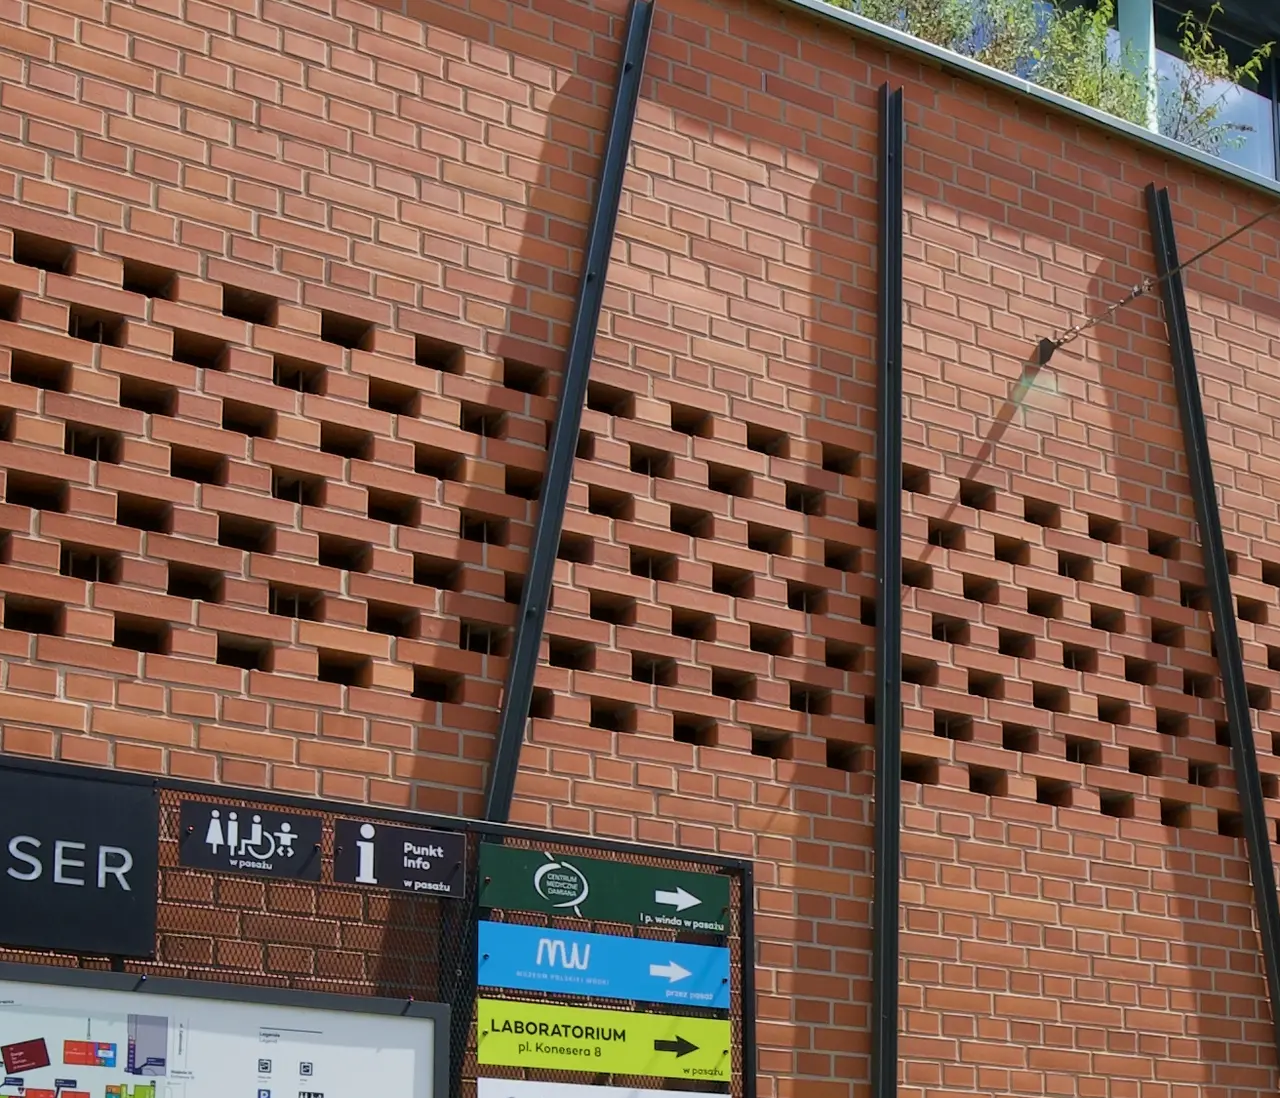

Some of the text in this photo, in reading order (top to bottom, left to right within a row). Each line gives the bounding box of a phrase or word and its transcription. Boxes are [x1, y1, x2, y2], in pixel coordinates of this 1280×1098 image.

[403, 841, 444, 858] Punkt
[230, 858, 272, 872] w pasażu
[403, 857, 431, 871] Info
[547, 872, 577, 882] CENTRUM
[404, 880, 450, 894] w pasażu
[645, 916, 653, 925] p.
[656, 915, 681, 926] winda
[693, 919, 724, 931] pasażu
[666, 989, 713, 1001] przez pasaż
[491, 1019, 626, 1042] LABORATORIUM
[518, 1042, 601, 1056] pl. Konesera 8
[691, 1067, 723, 1077] pasażu
